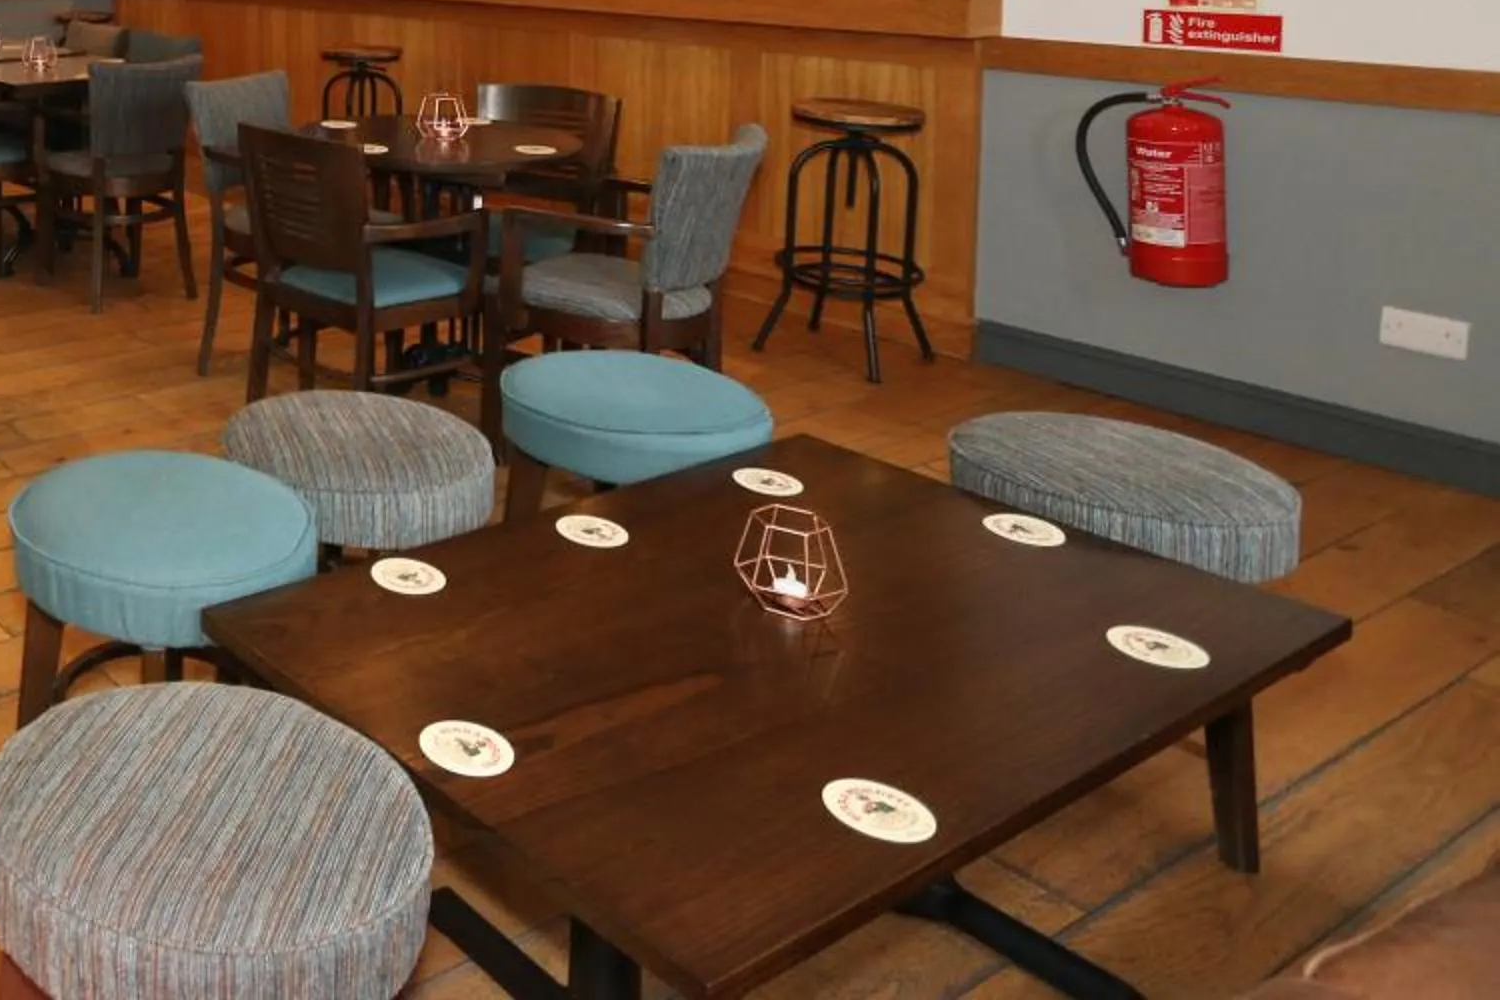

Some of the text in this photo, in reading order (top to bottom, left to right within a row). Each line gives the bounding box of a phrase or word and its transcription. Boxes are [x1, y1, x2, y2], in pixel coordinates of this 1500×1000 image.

[1187, 16, 1216, 29] Fire
[1187, 29, 1278, 45] extinguisher
[1135, 146, 1173, 160] Water
